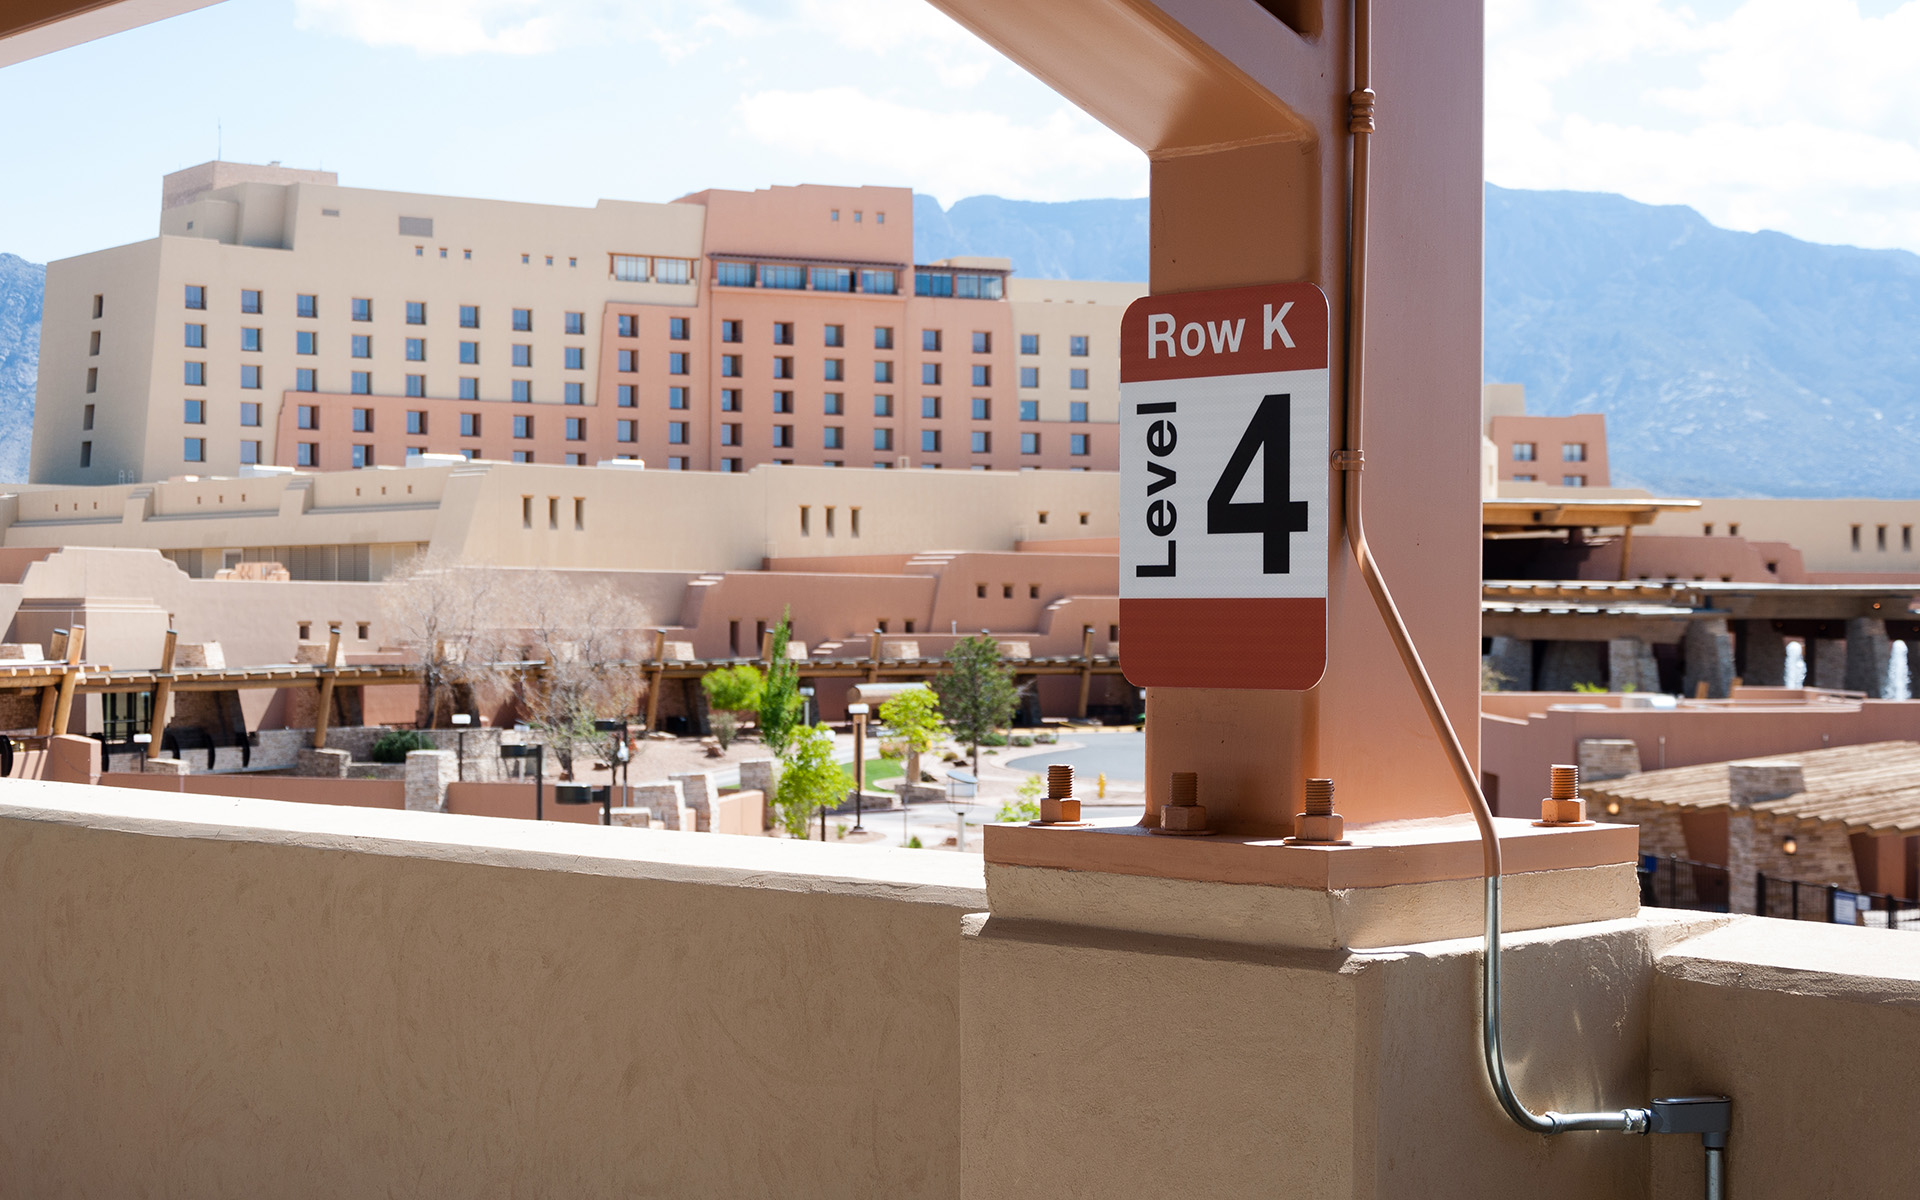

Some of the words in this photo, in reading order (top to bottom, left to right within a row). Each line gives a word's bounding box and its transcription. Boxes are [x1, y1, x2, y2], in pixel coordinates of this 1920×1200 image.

[1147, 312, 1246, 360] Row
[1263, 302, 1296, 350] K
[1136, 401, 1178, 578] Level
[1207, 393, 1309, 574] 4
